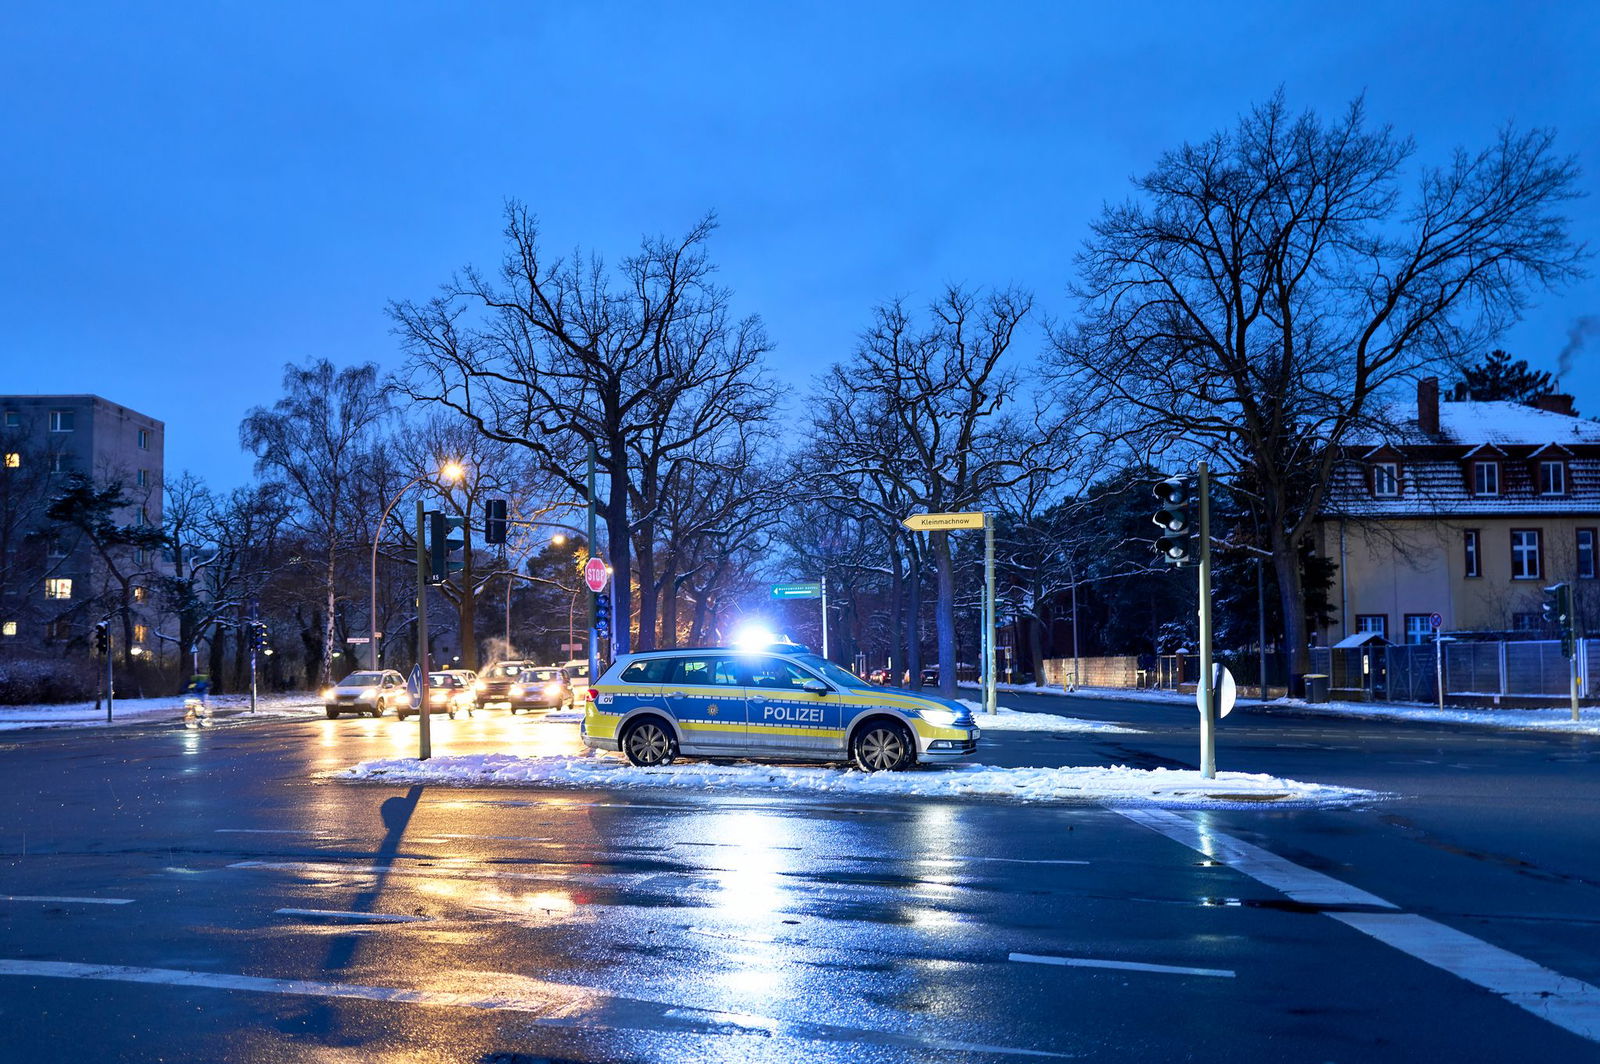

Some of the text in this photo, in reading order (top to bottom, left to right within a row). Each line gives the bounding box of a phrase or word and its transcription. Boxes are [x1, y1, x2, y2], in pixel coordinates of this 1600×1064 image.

[921, 518, 970, 526] Kleinmachnow
[587, 568, 605, 582] STOP
[763, 706, 825, 722] POLIZEI
